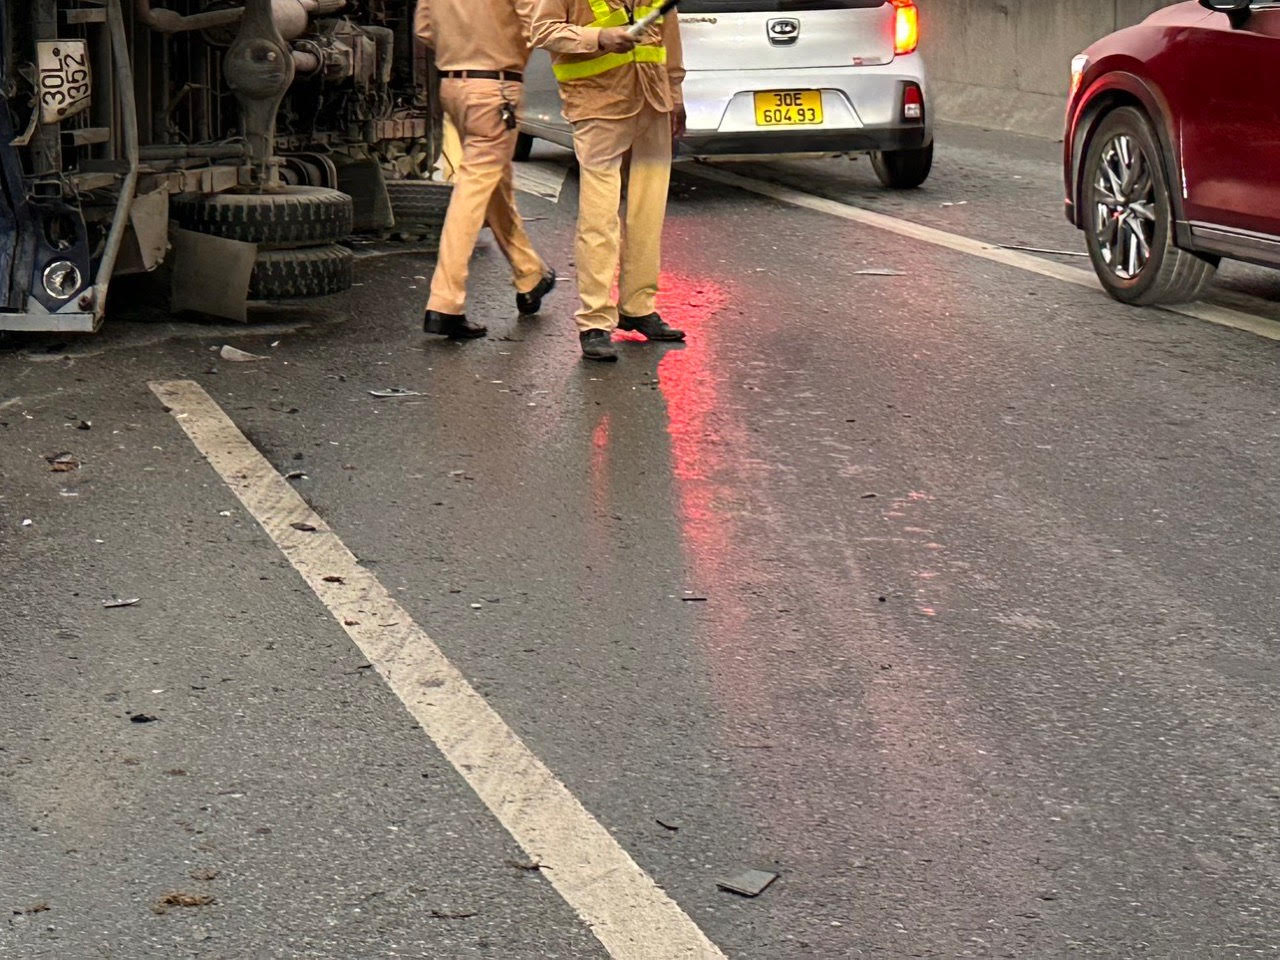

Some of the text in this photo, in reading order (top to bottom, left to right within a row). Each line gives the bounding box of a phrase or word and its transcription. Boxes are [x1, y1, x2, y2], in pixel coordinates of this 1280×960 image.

[40, 57, 66, 106] 30L
[773, 92, 803, 107] 30E
[763, 108, 816, 123] 604.93
